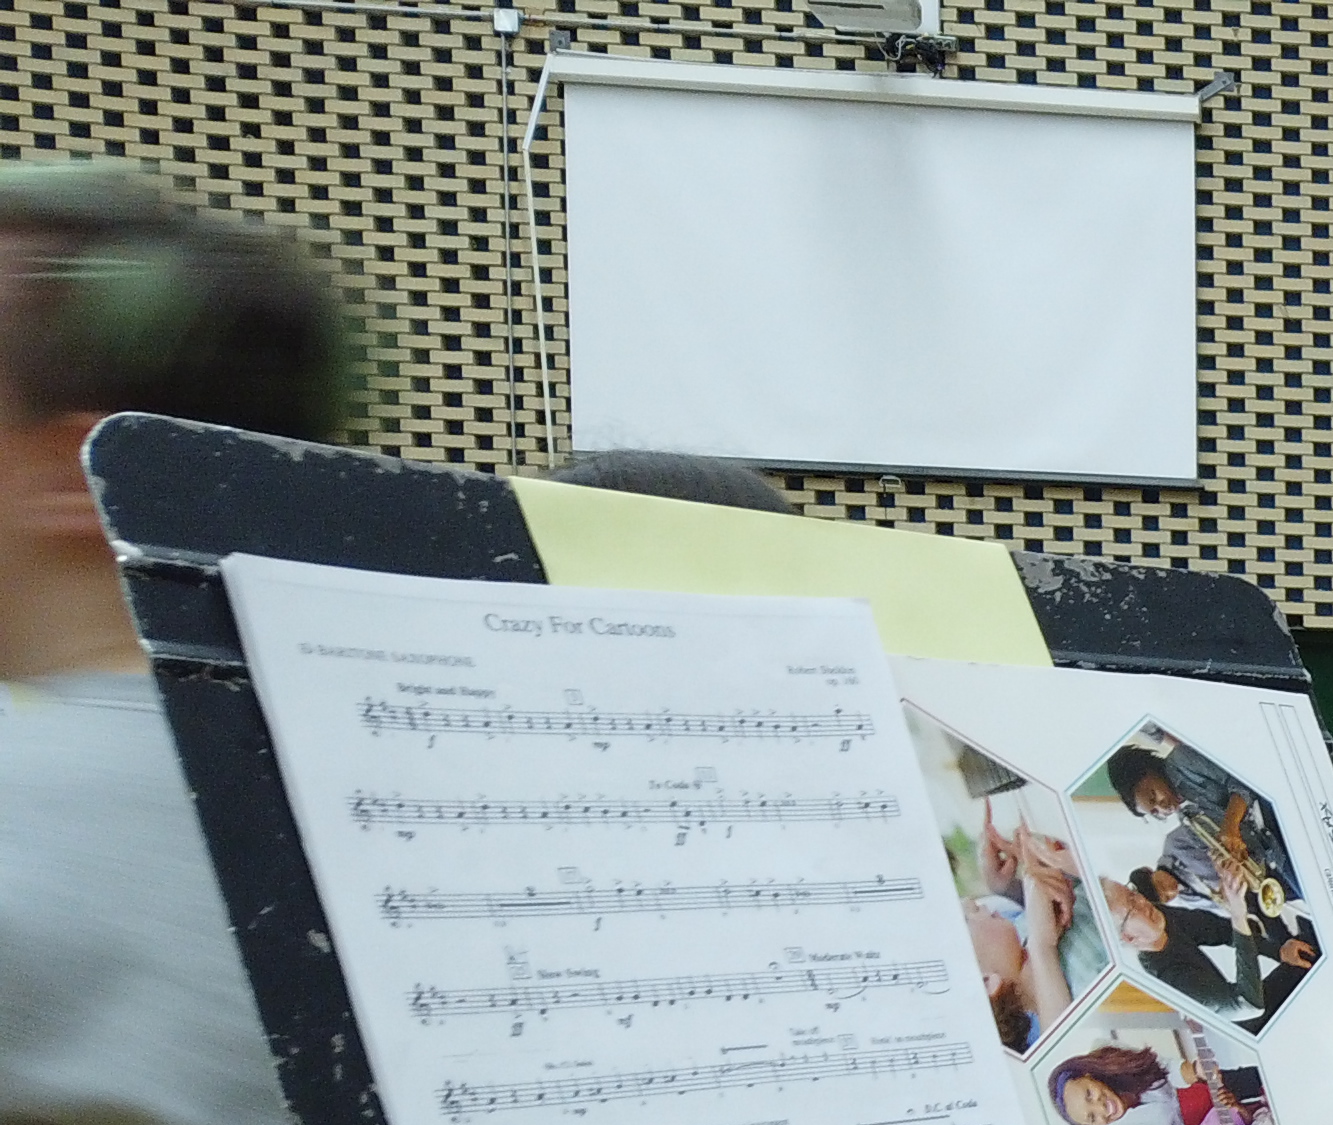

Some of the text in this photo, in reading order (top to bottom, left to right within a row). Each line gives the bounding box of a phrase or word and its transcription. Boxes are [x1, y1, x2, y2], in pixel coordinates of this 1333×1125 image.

[484, 613, 677, 638] Crazy For Cartoons
